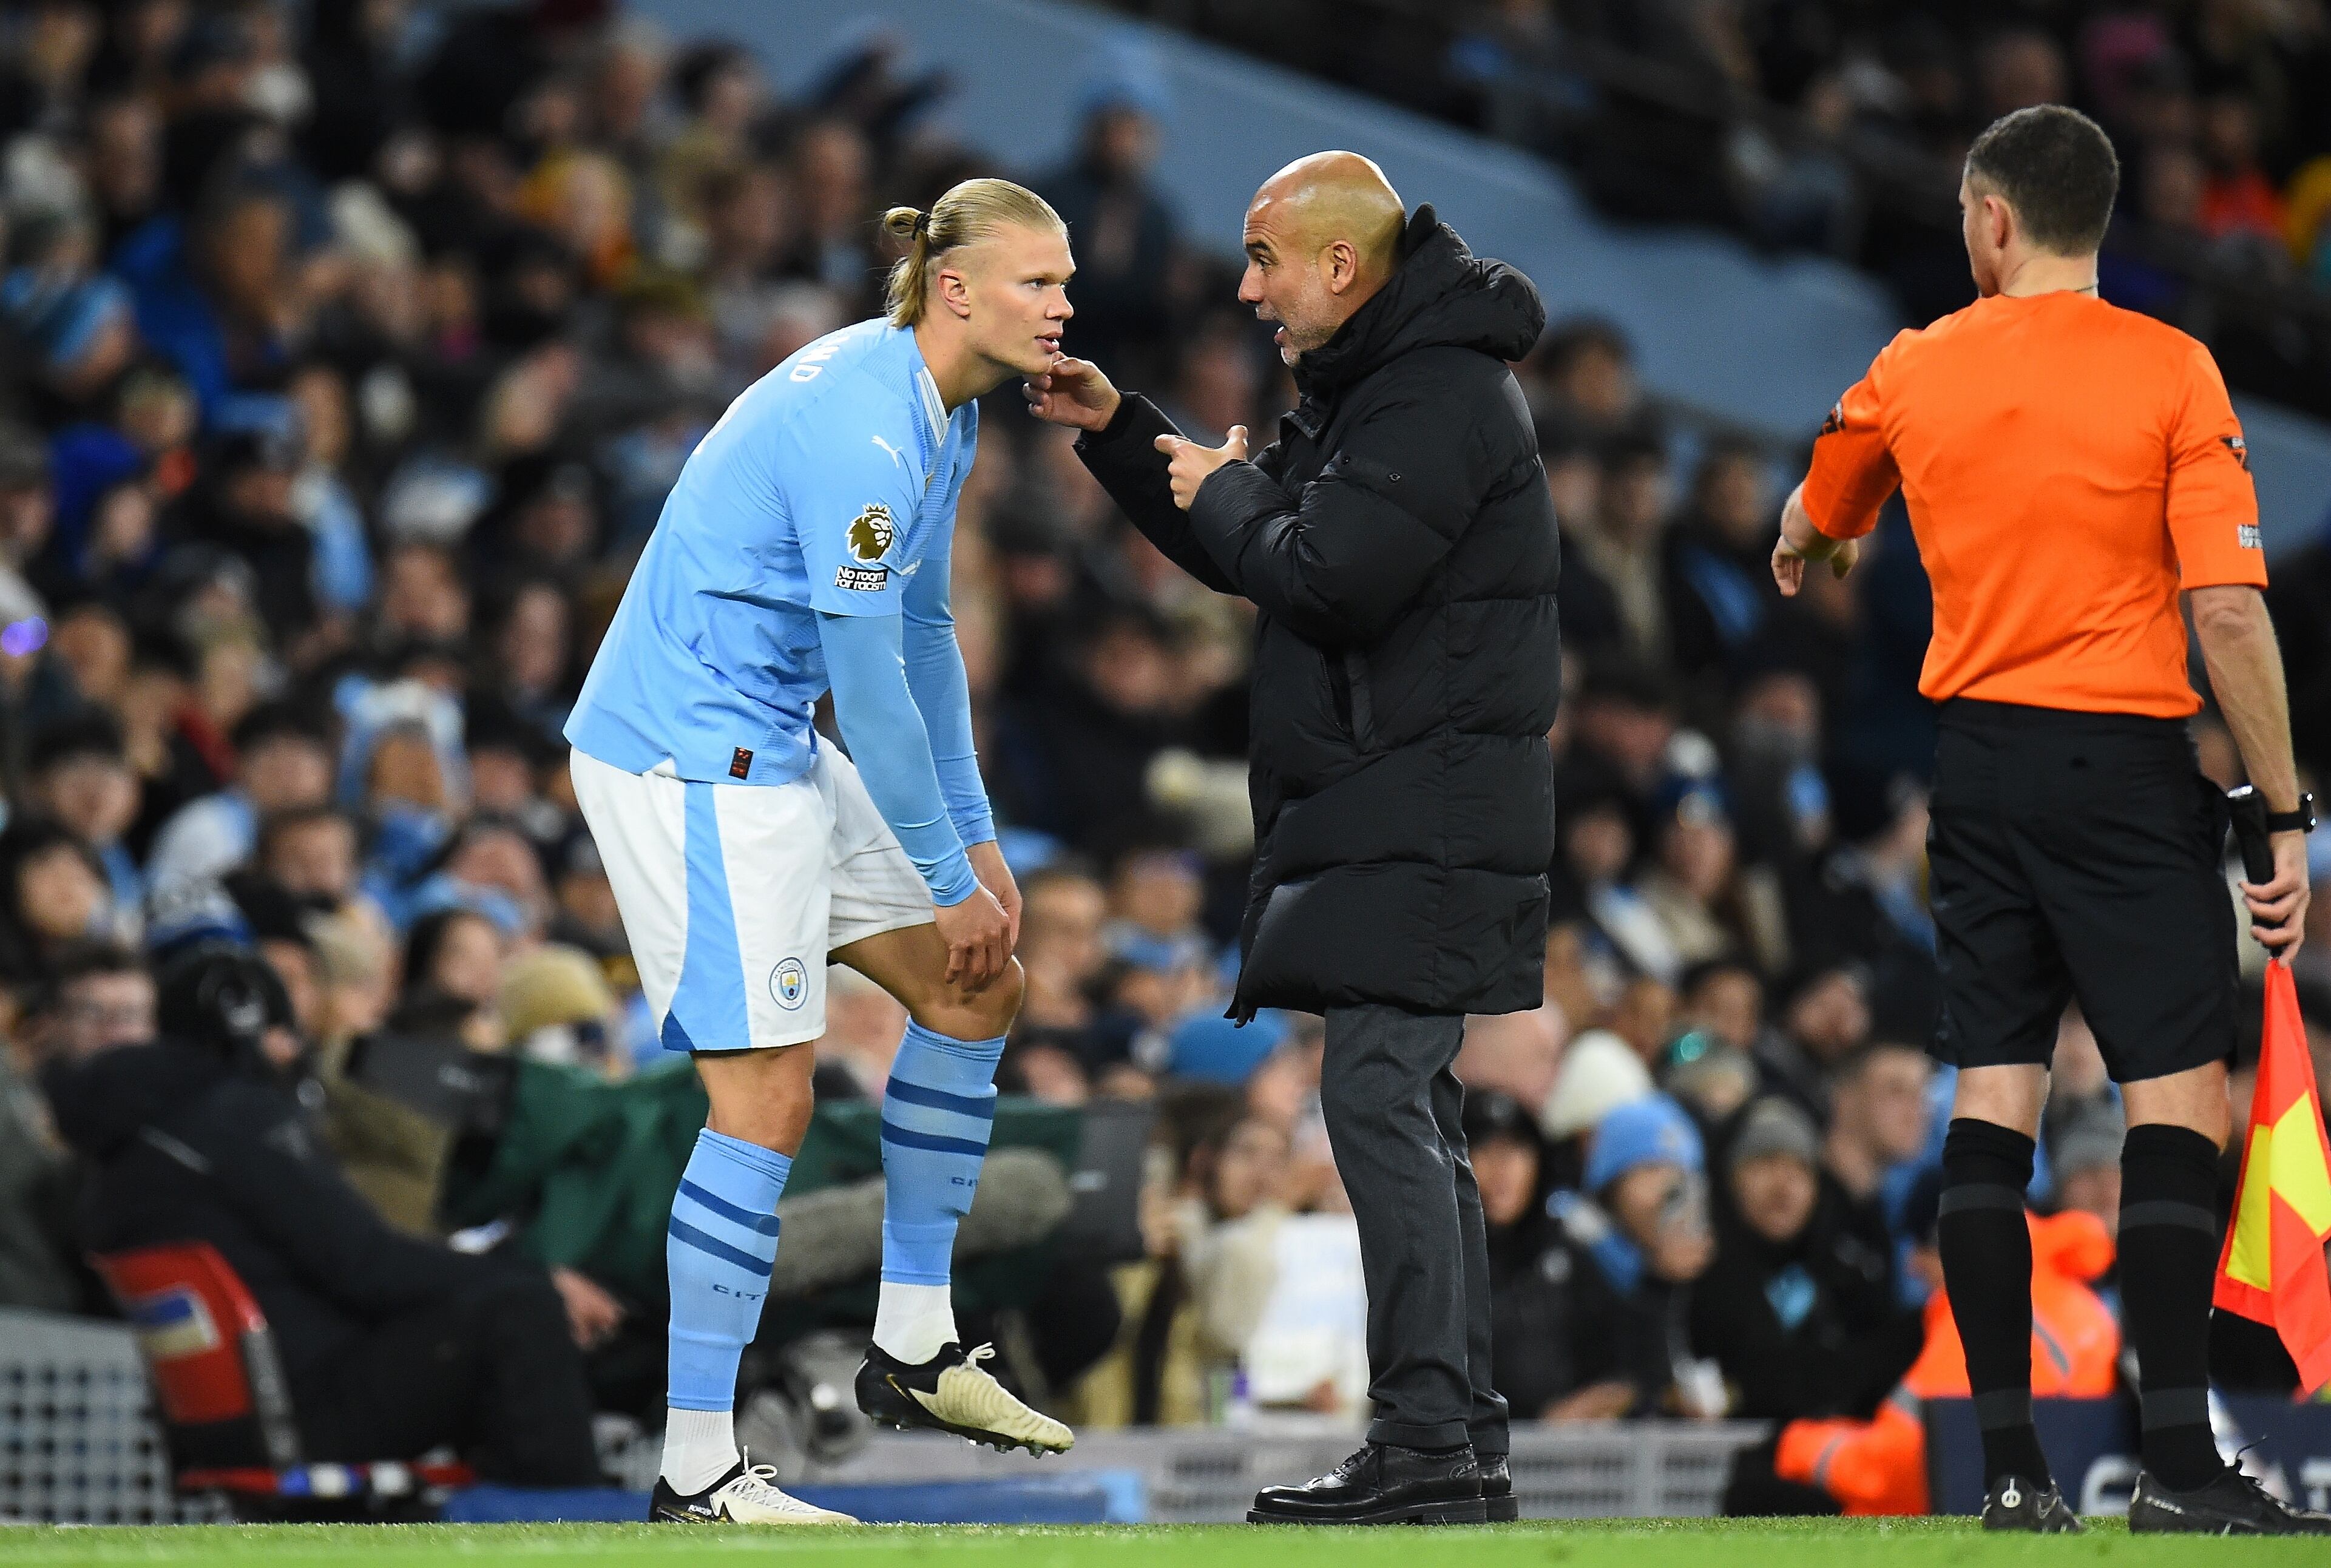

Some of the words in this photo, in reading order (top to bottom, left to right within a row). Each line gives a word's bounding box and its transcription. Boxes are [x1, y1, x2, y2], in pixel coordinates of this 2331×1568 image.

[836, 566, 856, 580] No
[856, 571, 884, 582] room
[853, 581, 886, 591] racism
